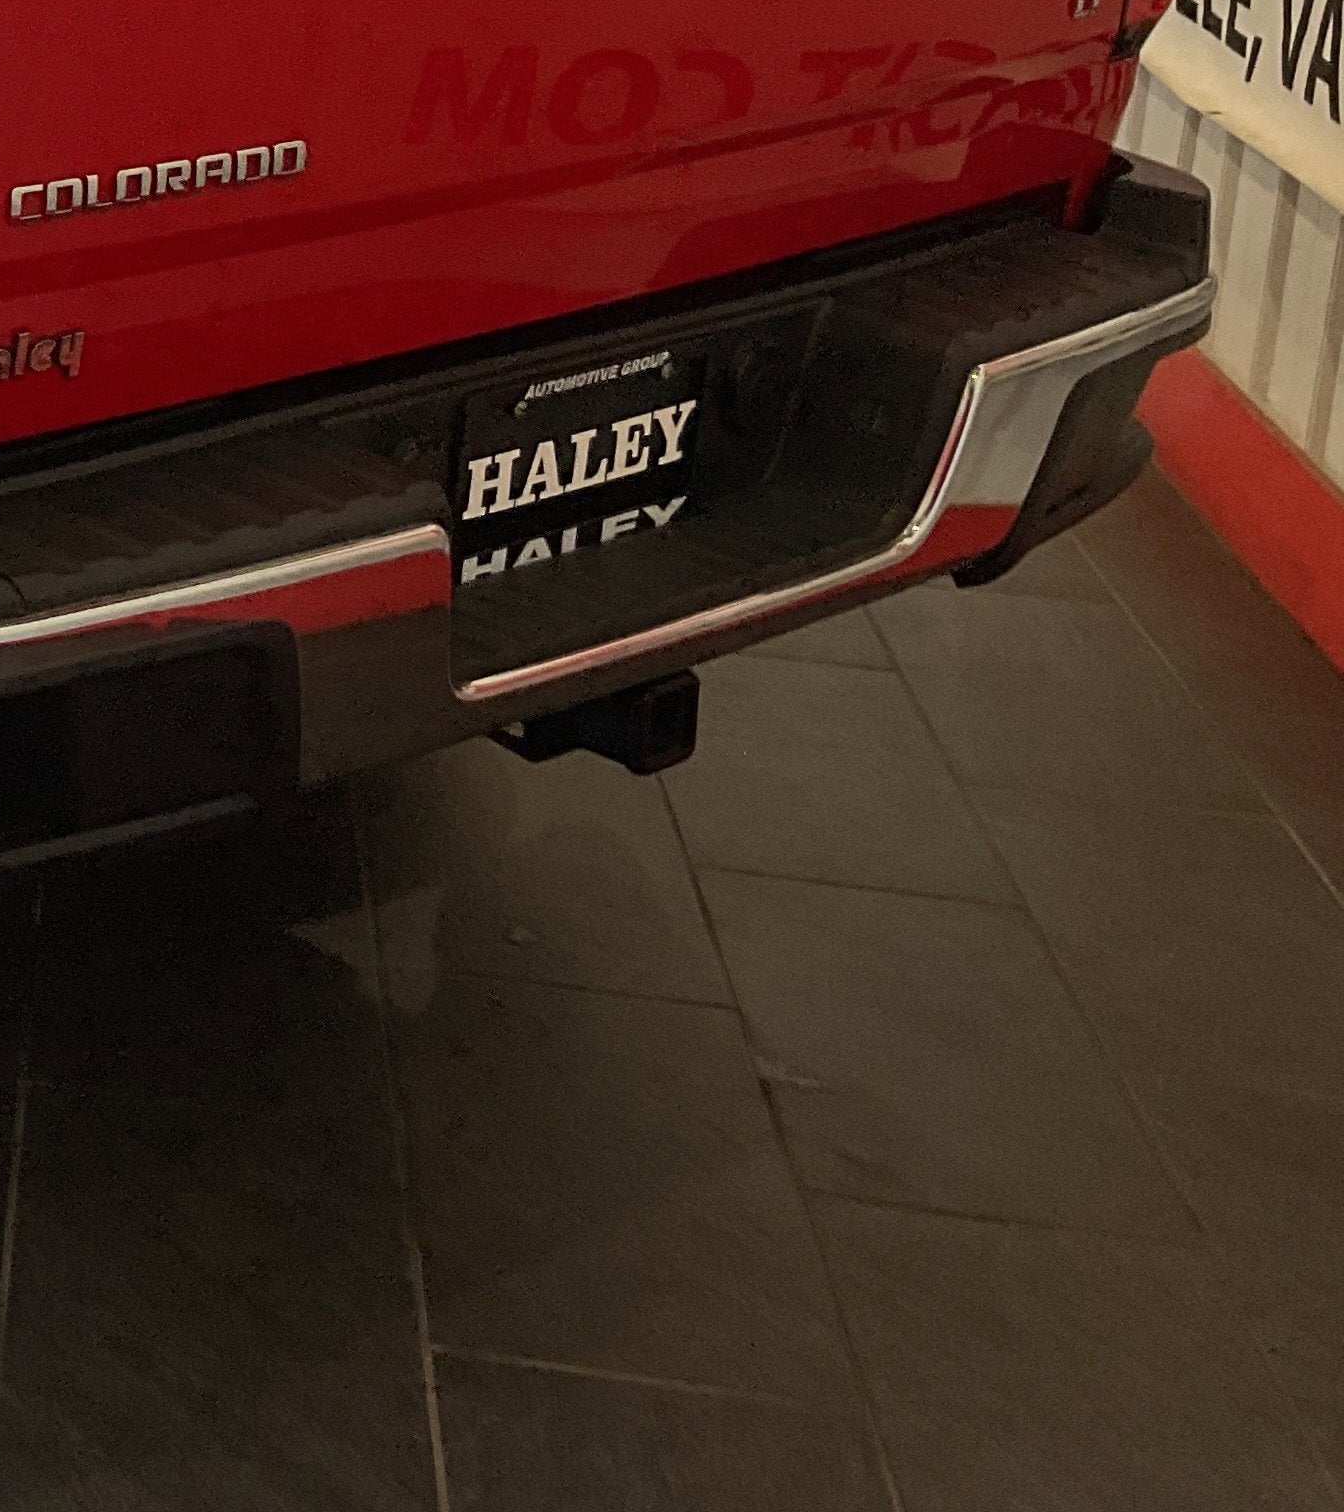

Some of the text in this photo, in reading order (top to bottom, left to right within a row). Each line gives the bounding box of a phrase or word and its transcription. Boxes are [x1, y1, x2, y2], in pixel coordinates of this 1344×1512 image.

[10, 139, 307, 221] COLORADO
[524, 350, 670, 400] AUTOMOTIVE GROUP
[462, 399, 698, 521] HALEY
